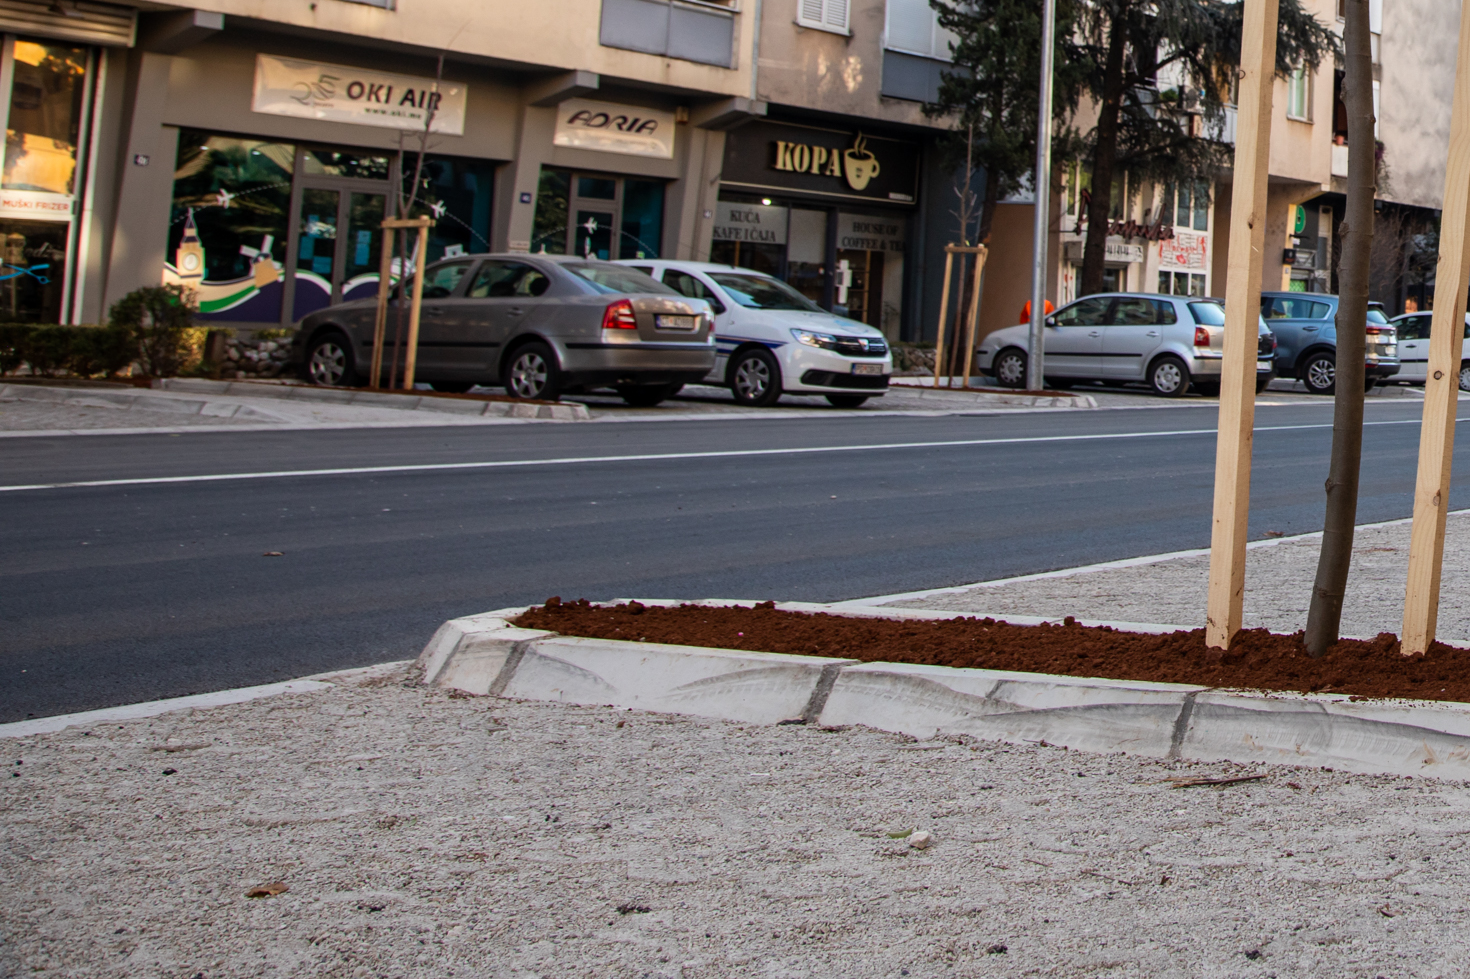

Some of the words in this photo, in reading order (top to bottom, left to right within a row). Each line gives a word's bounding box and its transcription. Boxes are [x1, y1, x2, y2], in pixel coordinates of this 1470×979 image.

[346, 80, 393, 104] OKI
[398, 87, 443, 112] AIR
[566, 109, 659, 135] ADRIA
[774, 140, 842, 178] KOPA
[2, 198, 33, 209] MUŠKI
[35, 201, 70, 211] FRIZER
[712, 225, 743, 240] KAFE
[852, 221, 885, 235] HOUSE
[886, 224, 899, 237] OF
[842, 236, 879, 249] COFFEE
